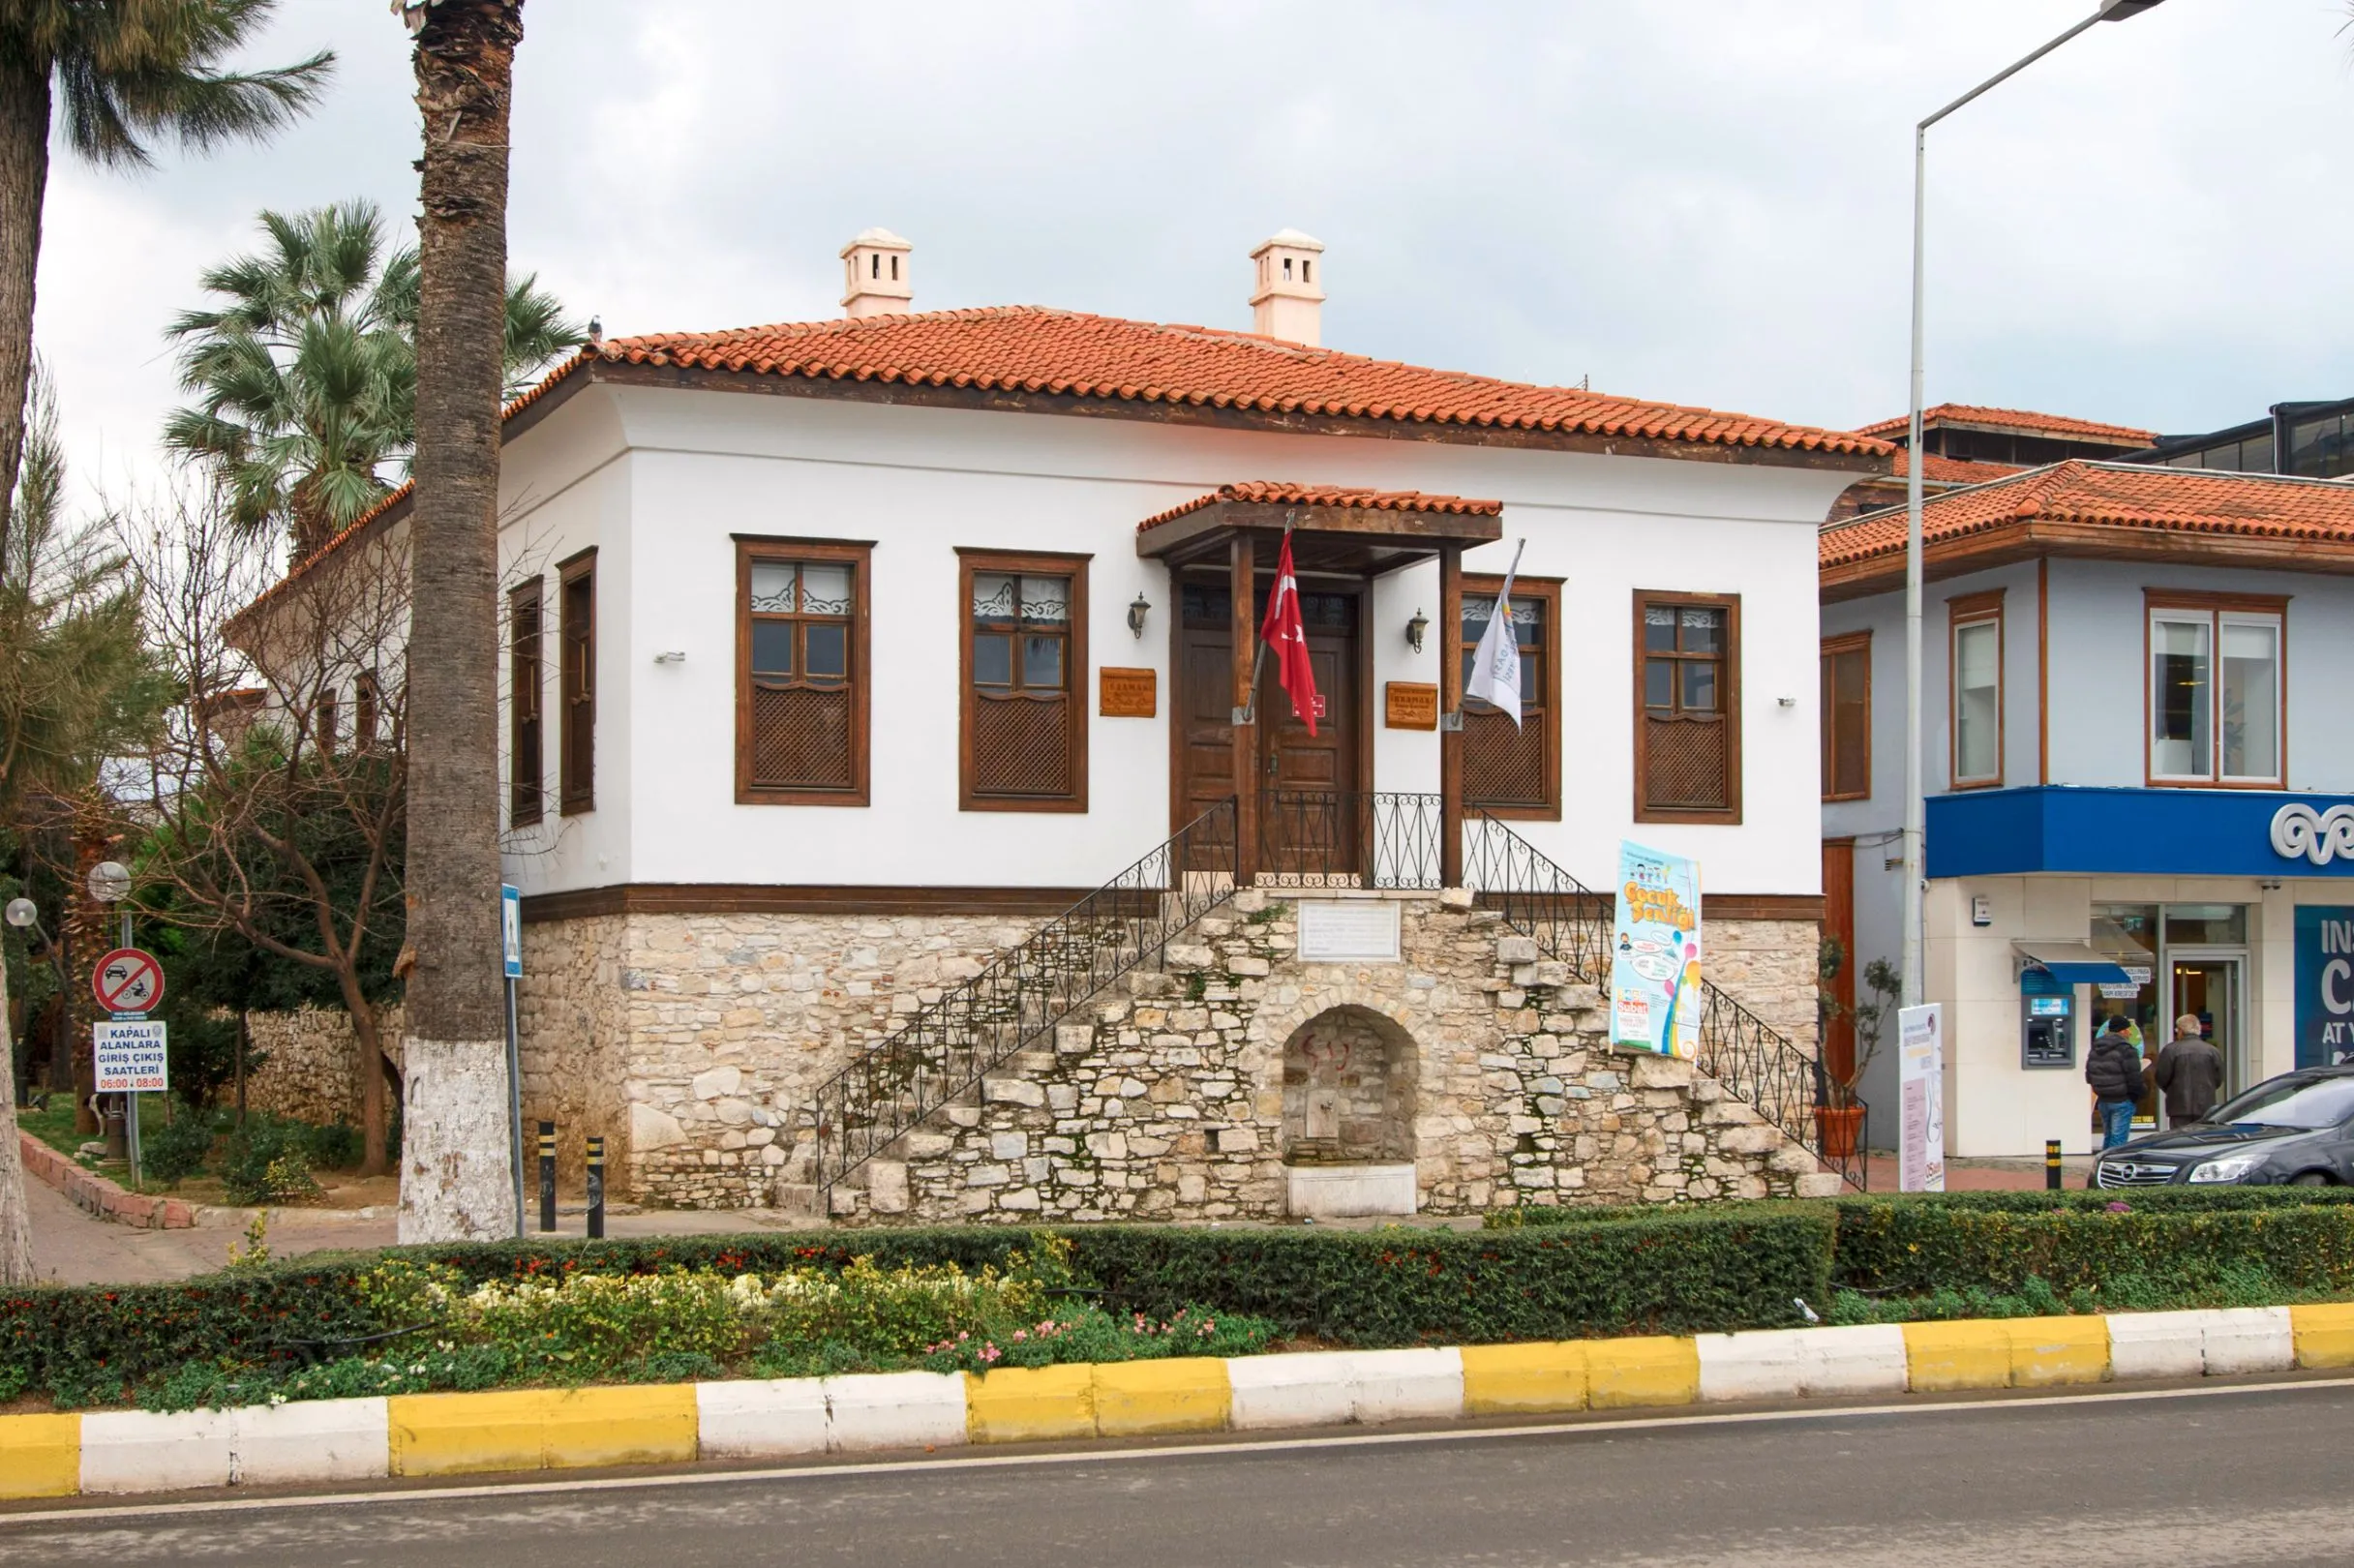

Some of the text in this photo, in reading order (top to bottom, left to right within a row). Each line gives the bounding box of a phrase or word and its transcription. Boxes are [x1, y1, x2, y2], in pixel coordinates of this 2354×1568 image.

[2321, 920, 2354, 953] IN
[2321, 958, 2354, 1015] C
[110, 1029, 150, 1039] KAPALI
[2322, 1021, 2345, 1044] AT
[100, 1040, 161, 1050] ALANLARA
[98, 1051, 164, 1064] GİRİŞ ÇIKIŞ
[105, 1065, 160, 1075] SAATLERİ
[101, 1077, 164, 1089] 06:00 08:00
